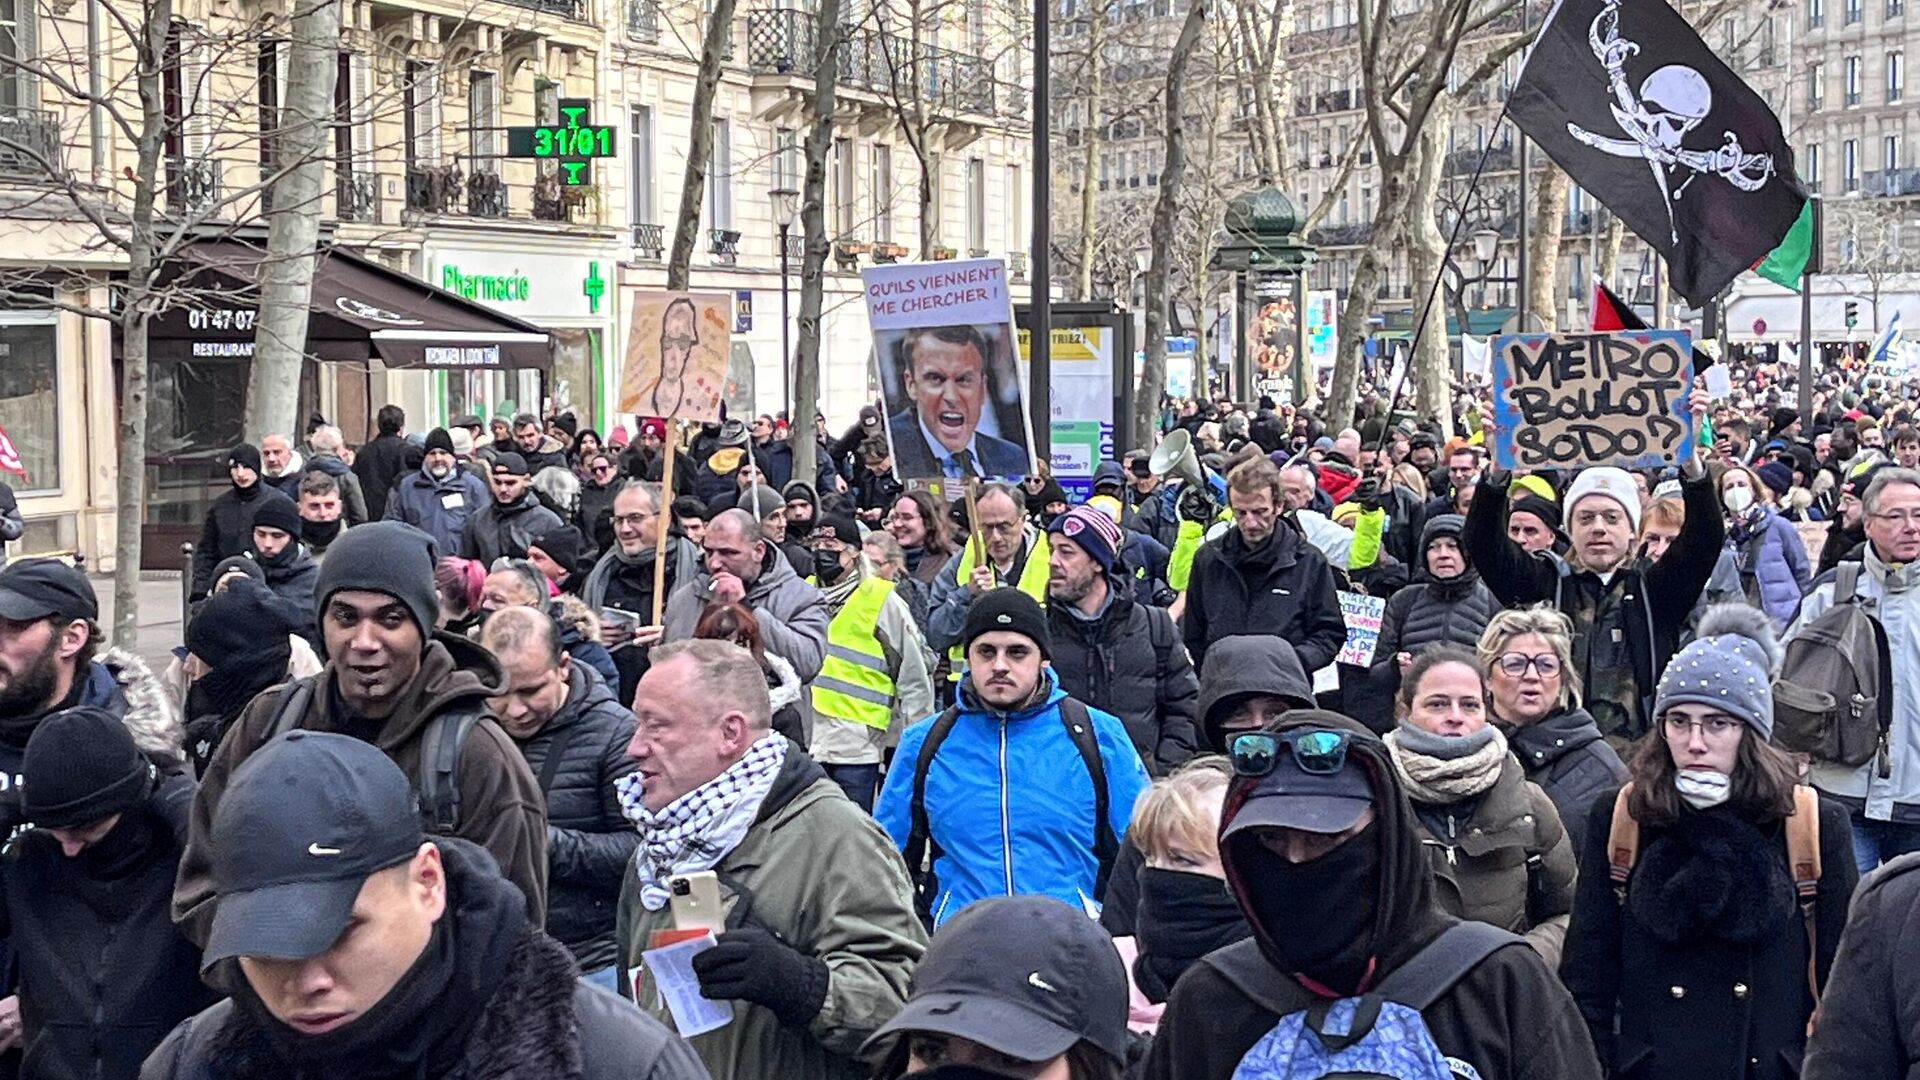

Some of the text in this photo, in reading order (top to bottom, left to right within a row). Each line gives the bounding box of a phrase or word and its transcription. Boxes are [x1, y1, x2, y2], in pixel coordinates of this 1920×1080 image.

[535, 128, 610, 155] 31/01
[442, 264, 529, 301] Pharmacie
[869, 267, 1000, 297] QU'ILS VIENNENT
[873, 300, 897, 315] ME
[901, 288, 988, 313] CHERCHER
[188, 309, 256, 330] 01 47 07
[1511, 334, 1680, 389] METRO
[1510, 379, 1682, 426] BOULOT
